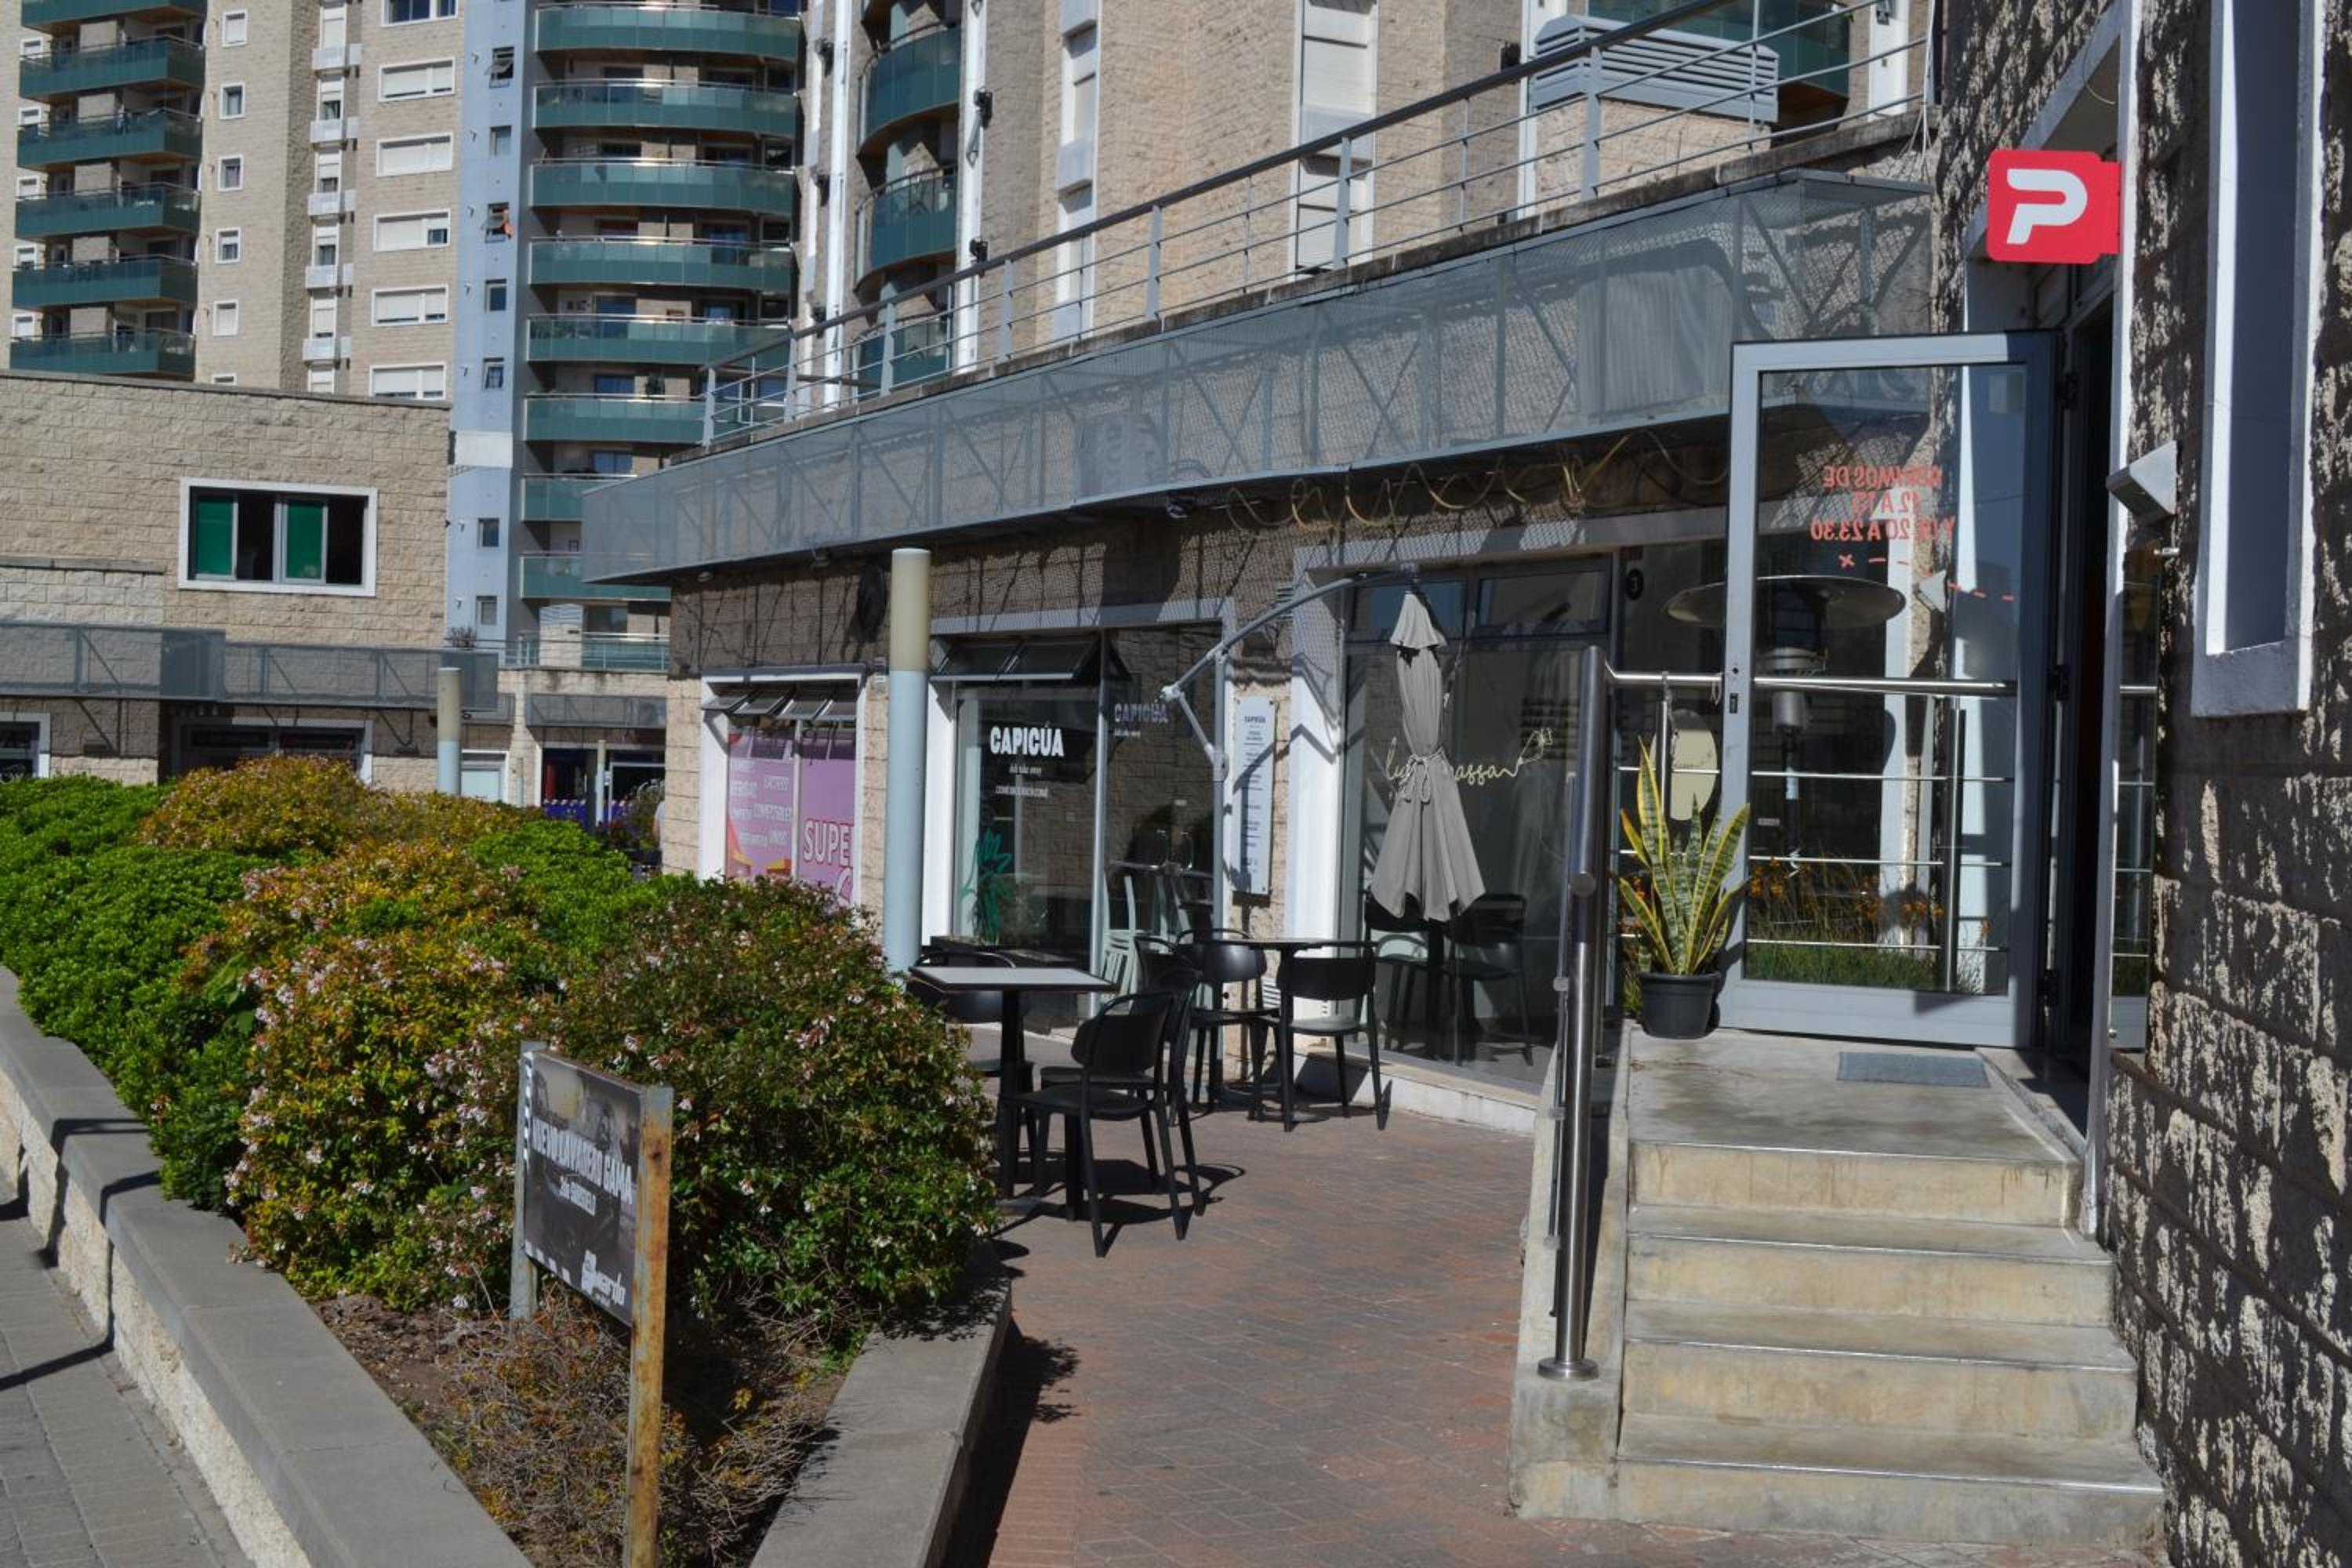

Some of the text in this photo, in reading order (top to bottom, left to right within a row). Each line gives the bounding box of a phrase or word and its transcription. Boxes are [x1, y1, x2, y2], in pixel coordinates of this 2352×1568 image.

[2007, 169, 2088, 245] P
[990, 721, 1064, 757] CAPICÚA
[803, 818, 854, 868] SUPE
[603, 1153, 633, 1205] GAMA
